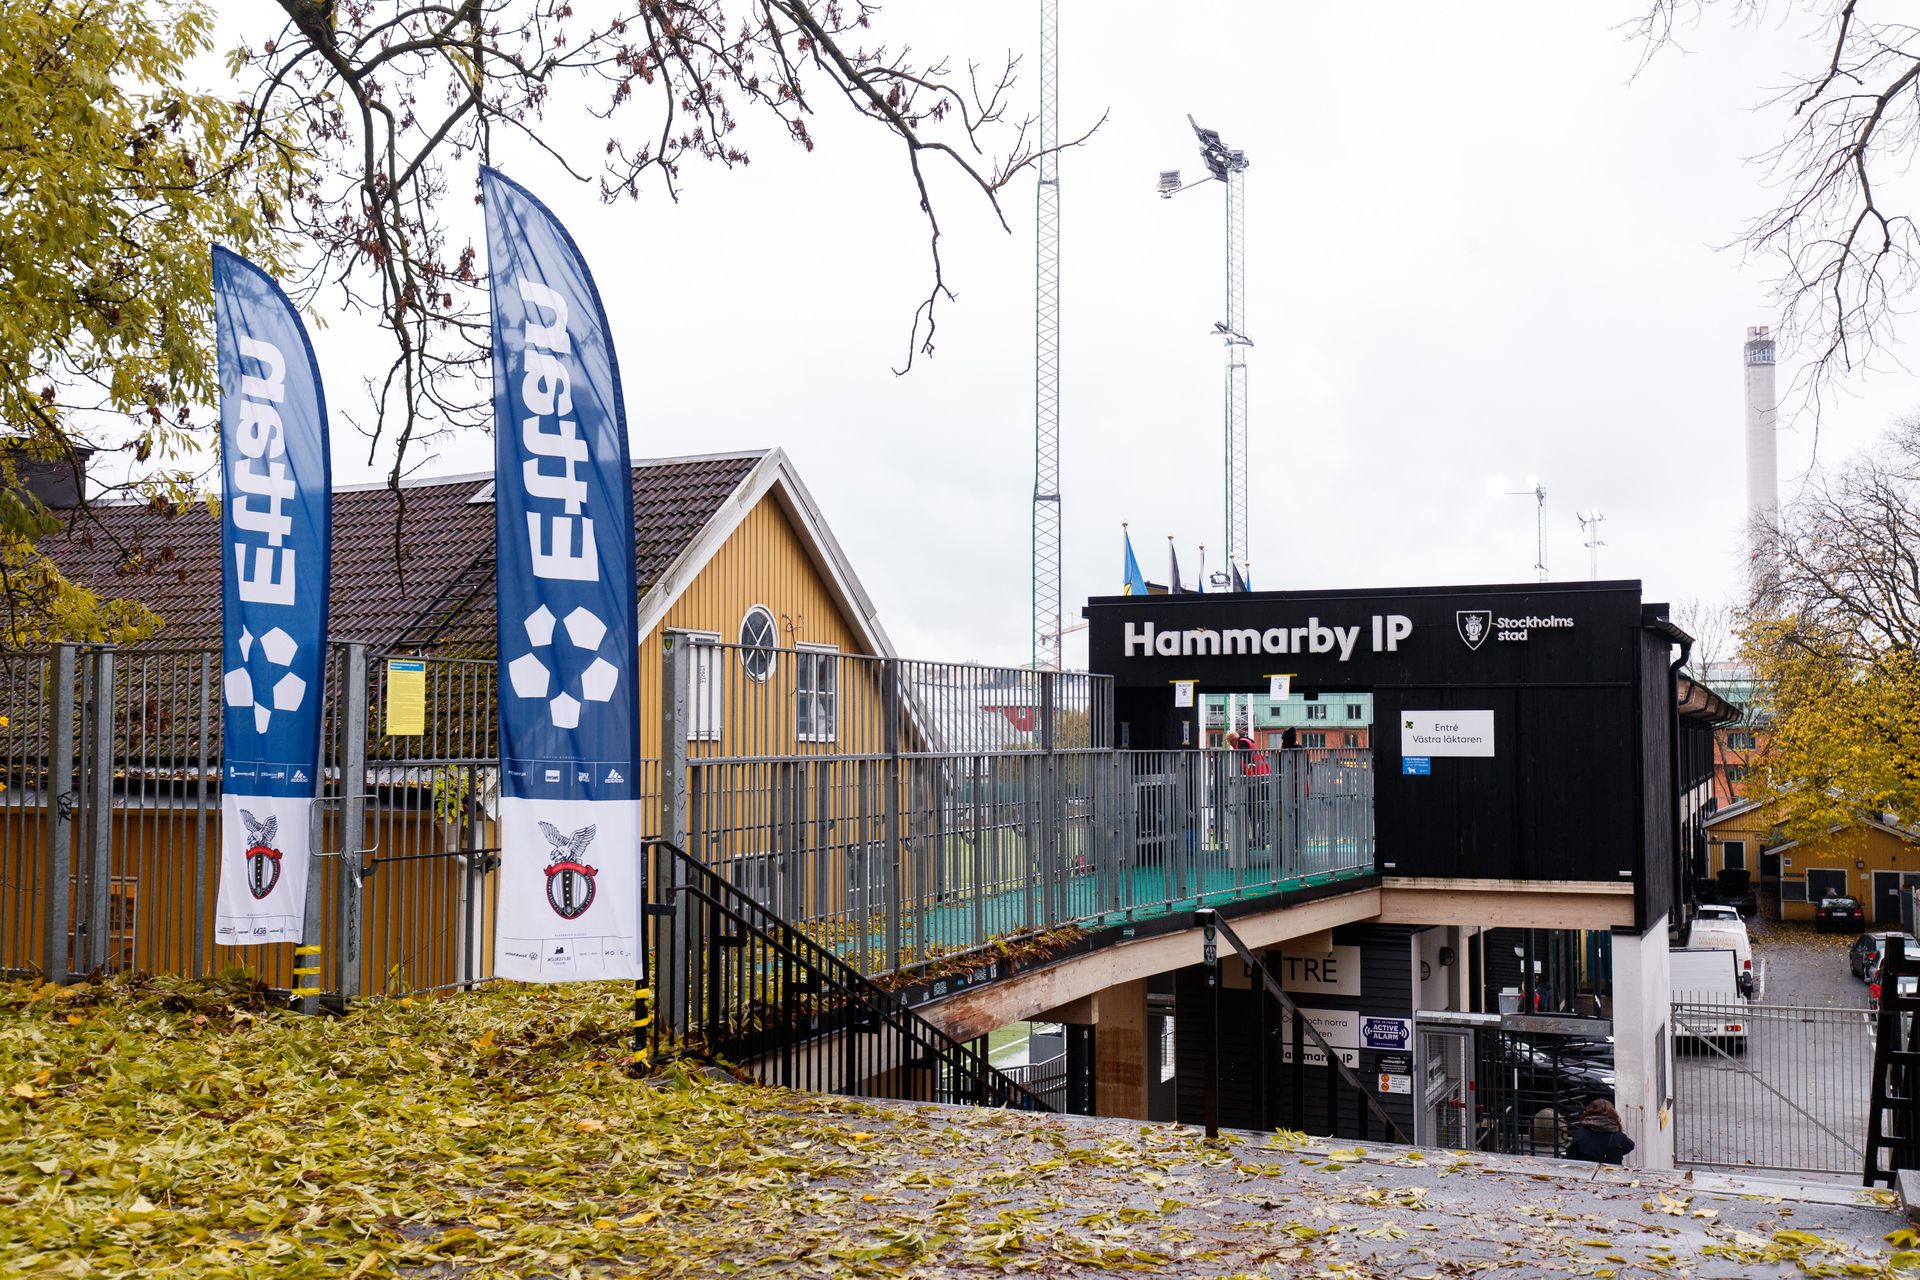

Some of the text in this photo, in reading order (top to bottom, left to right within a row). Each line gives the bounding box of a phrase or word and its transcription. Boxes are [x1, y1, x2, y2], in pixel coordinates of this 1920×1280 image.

[1497, 616, 1574, 628] Stockholms
[1125, 615, 1413, 661] Hammarby IP
[1497, 629, 1528, 641] stad
[1435, 723, 1459, 732] Entré
[1412, 735, 1482, 744] Västra läktaren
[1324, 1019, 1348, 1027] norra
[1373, 1032, 1399, 1040] ALARM
[1342, 1053, 1353, 1064] IP
